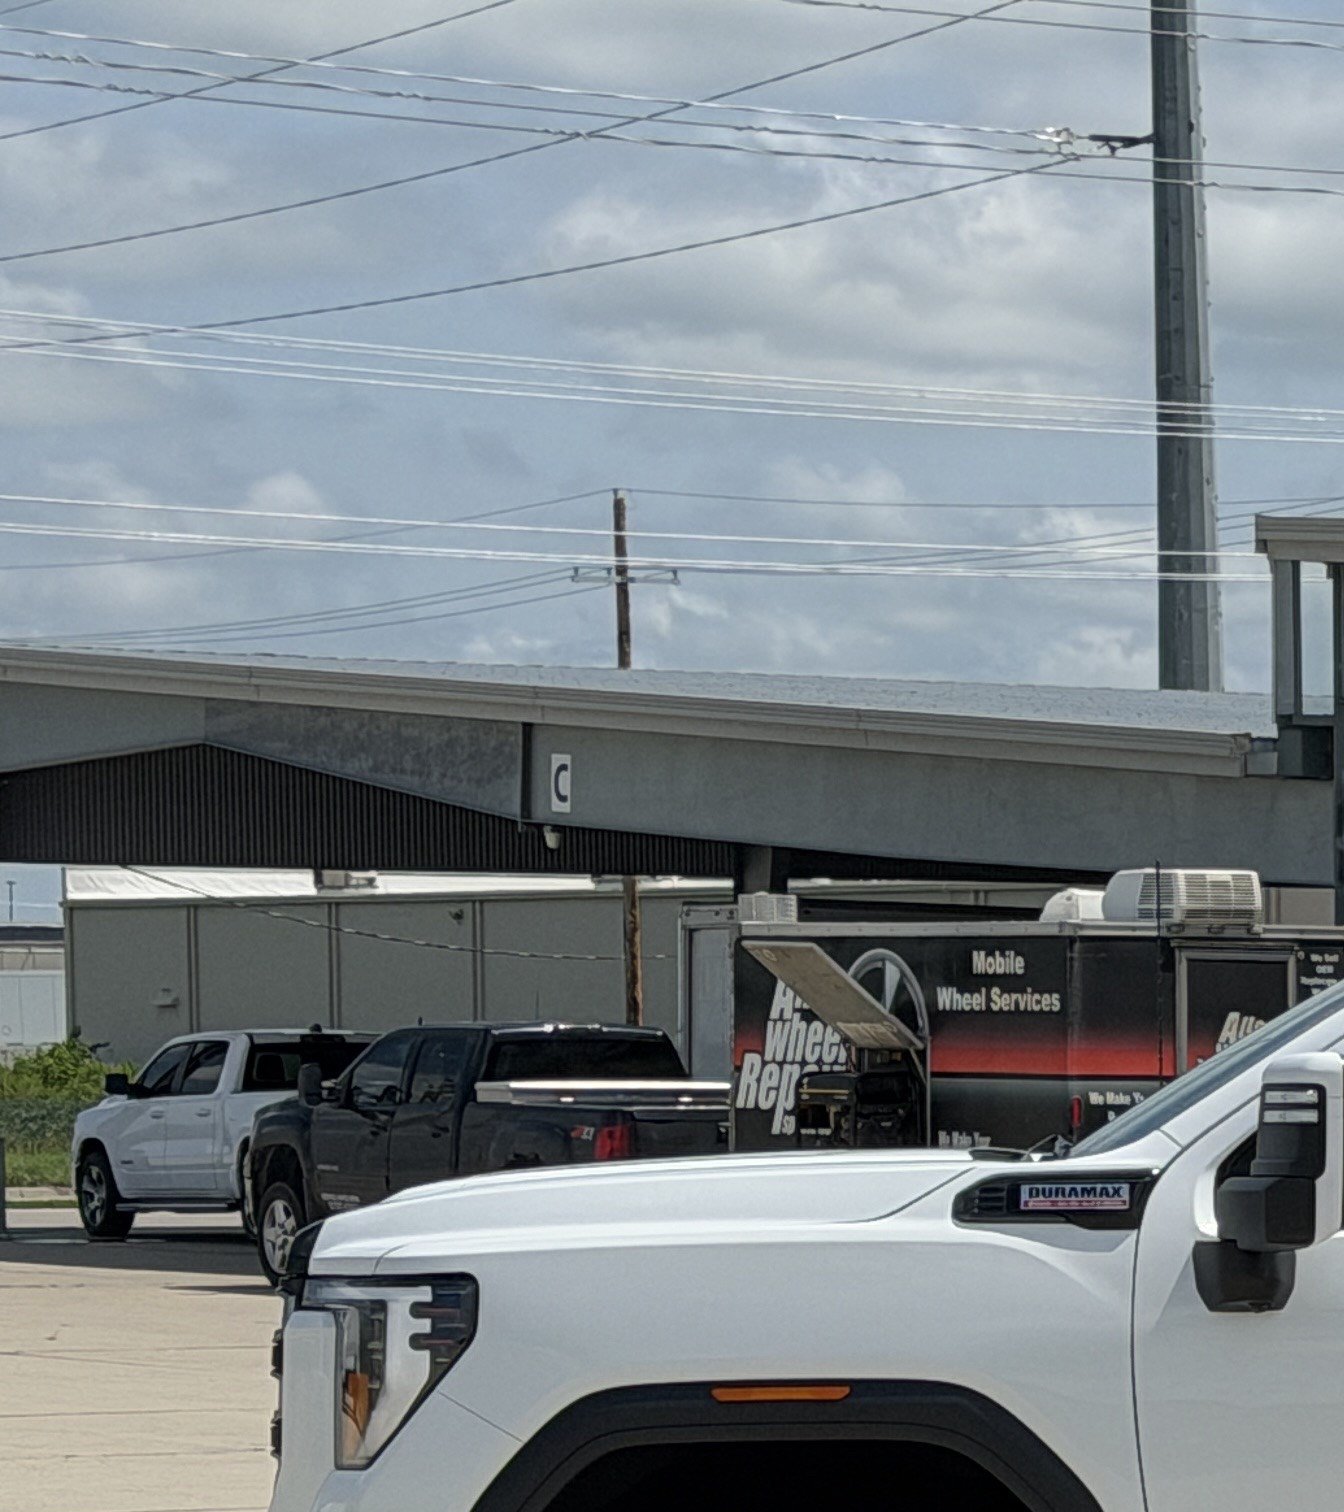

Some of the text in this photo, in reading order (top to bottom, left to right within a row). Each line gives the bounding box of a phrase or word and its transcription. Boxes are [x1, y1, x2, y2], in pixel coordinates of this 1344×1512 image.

[554, 763, 569, 803] C
[972, 950, 1025, 975] Mobile
[936, 986, 1061, 1012] Wheel Services
[1028, 1185, 1124, 1200] DURAMAX
